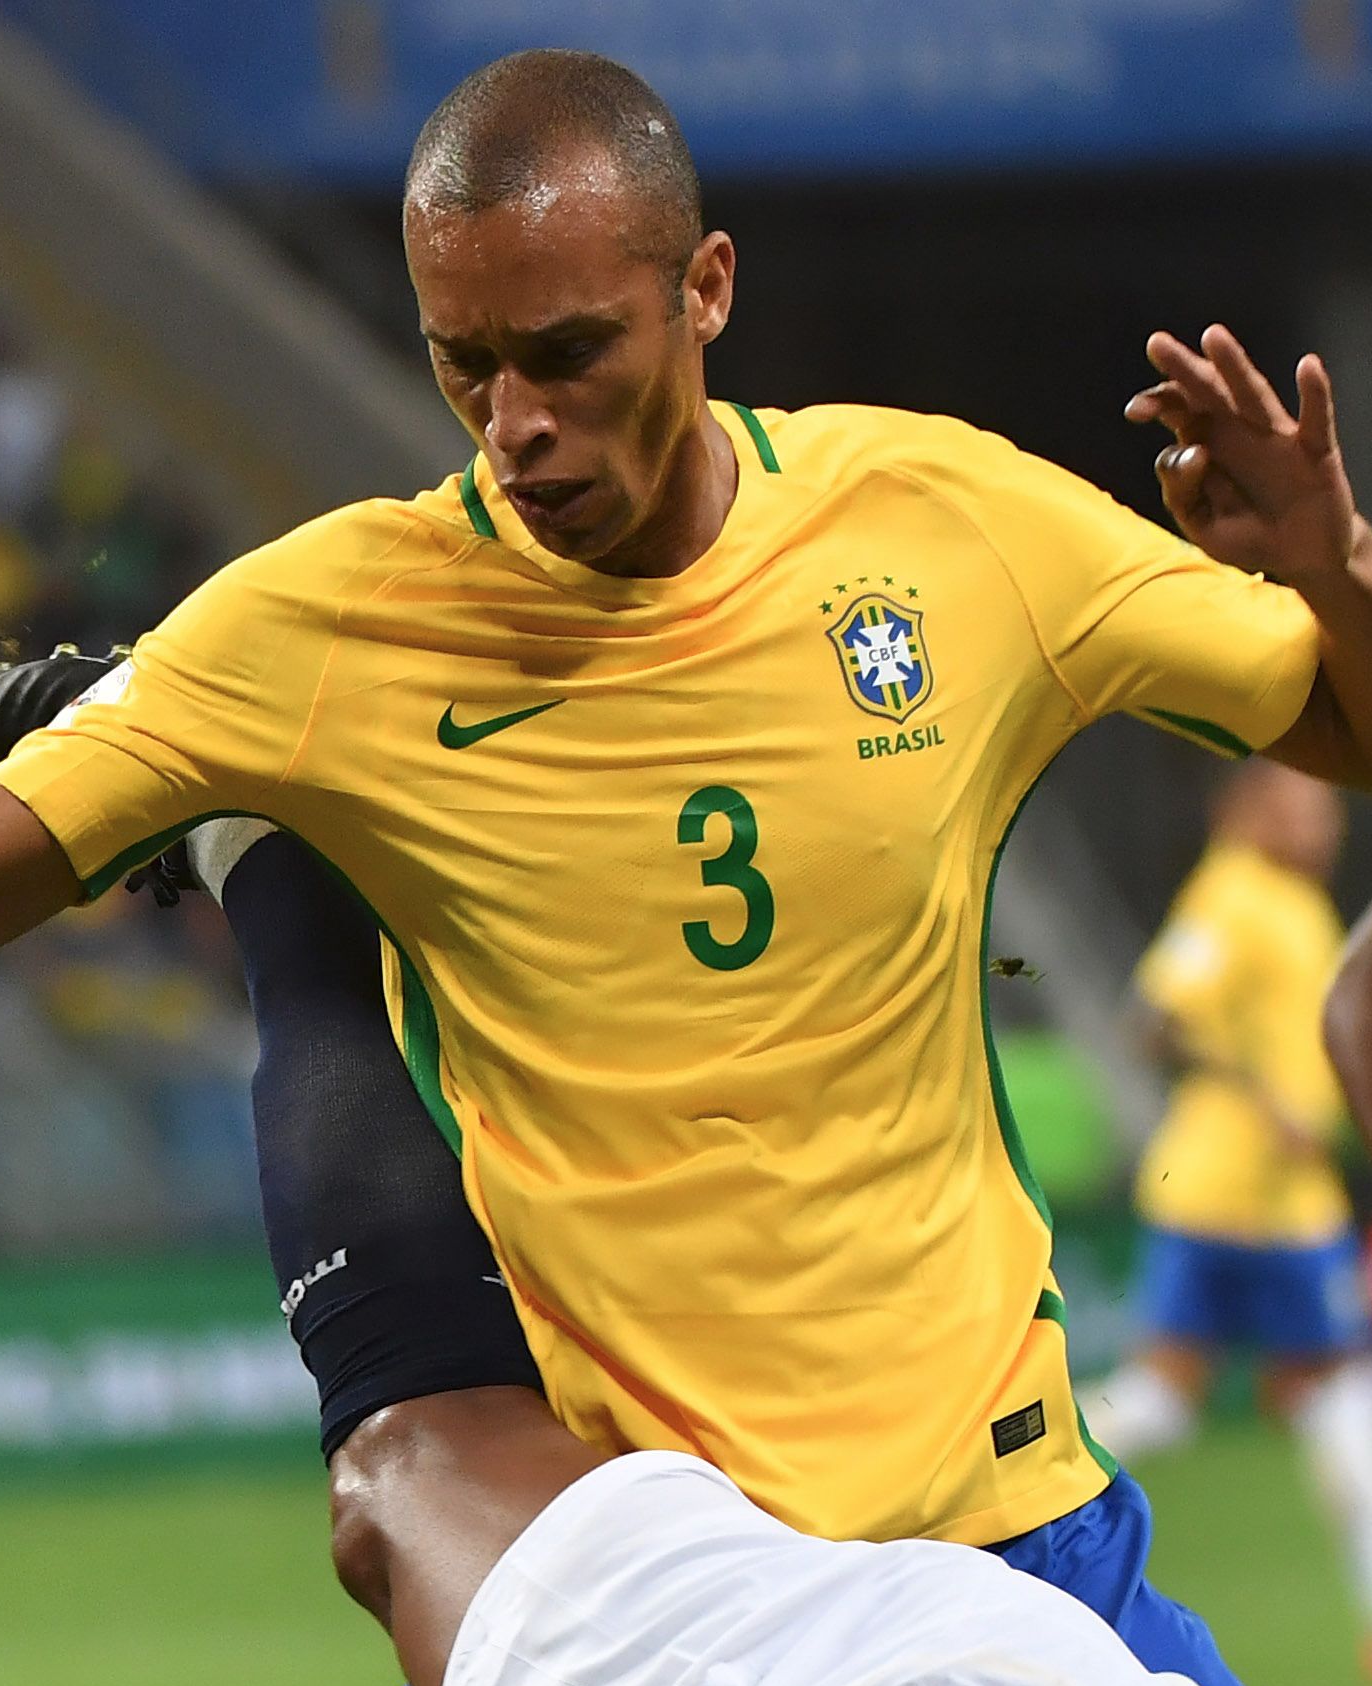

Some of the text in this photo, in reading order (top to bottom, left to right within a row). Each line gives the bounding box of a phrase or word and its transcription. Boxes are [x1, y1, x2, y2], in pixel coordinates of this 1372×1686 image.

[868, 644, 900, 664] CBF
[857, 724, 946, 760] BRASIL
[676, 785, 775, 972] 3
